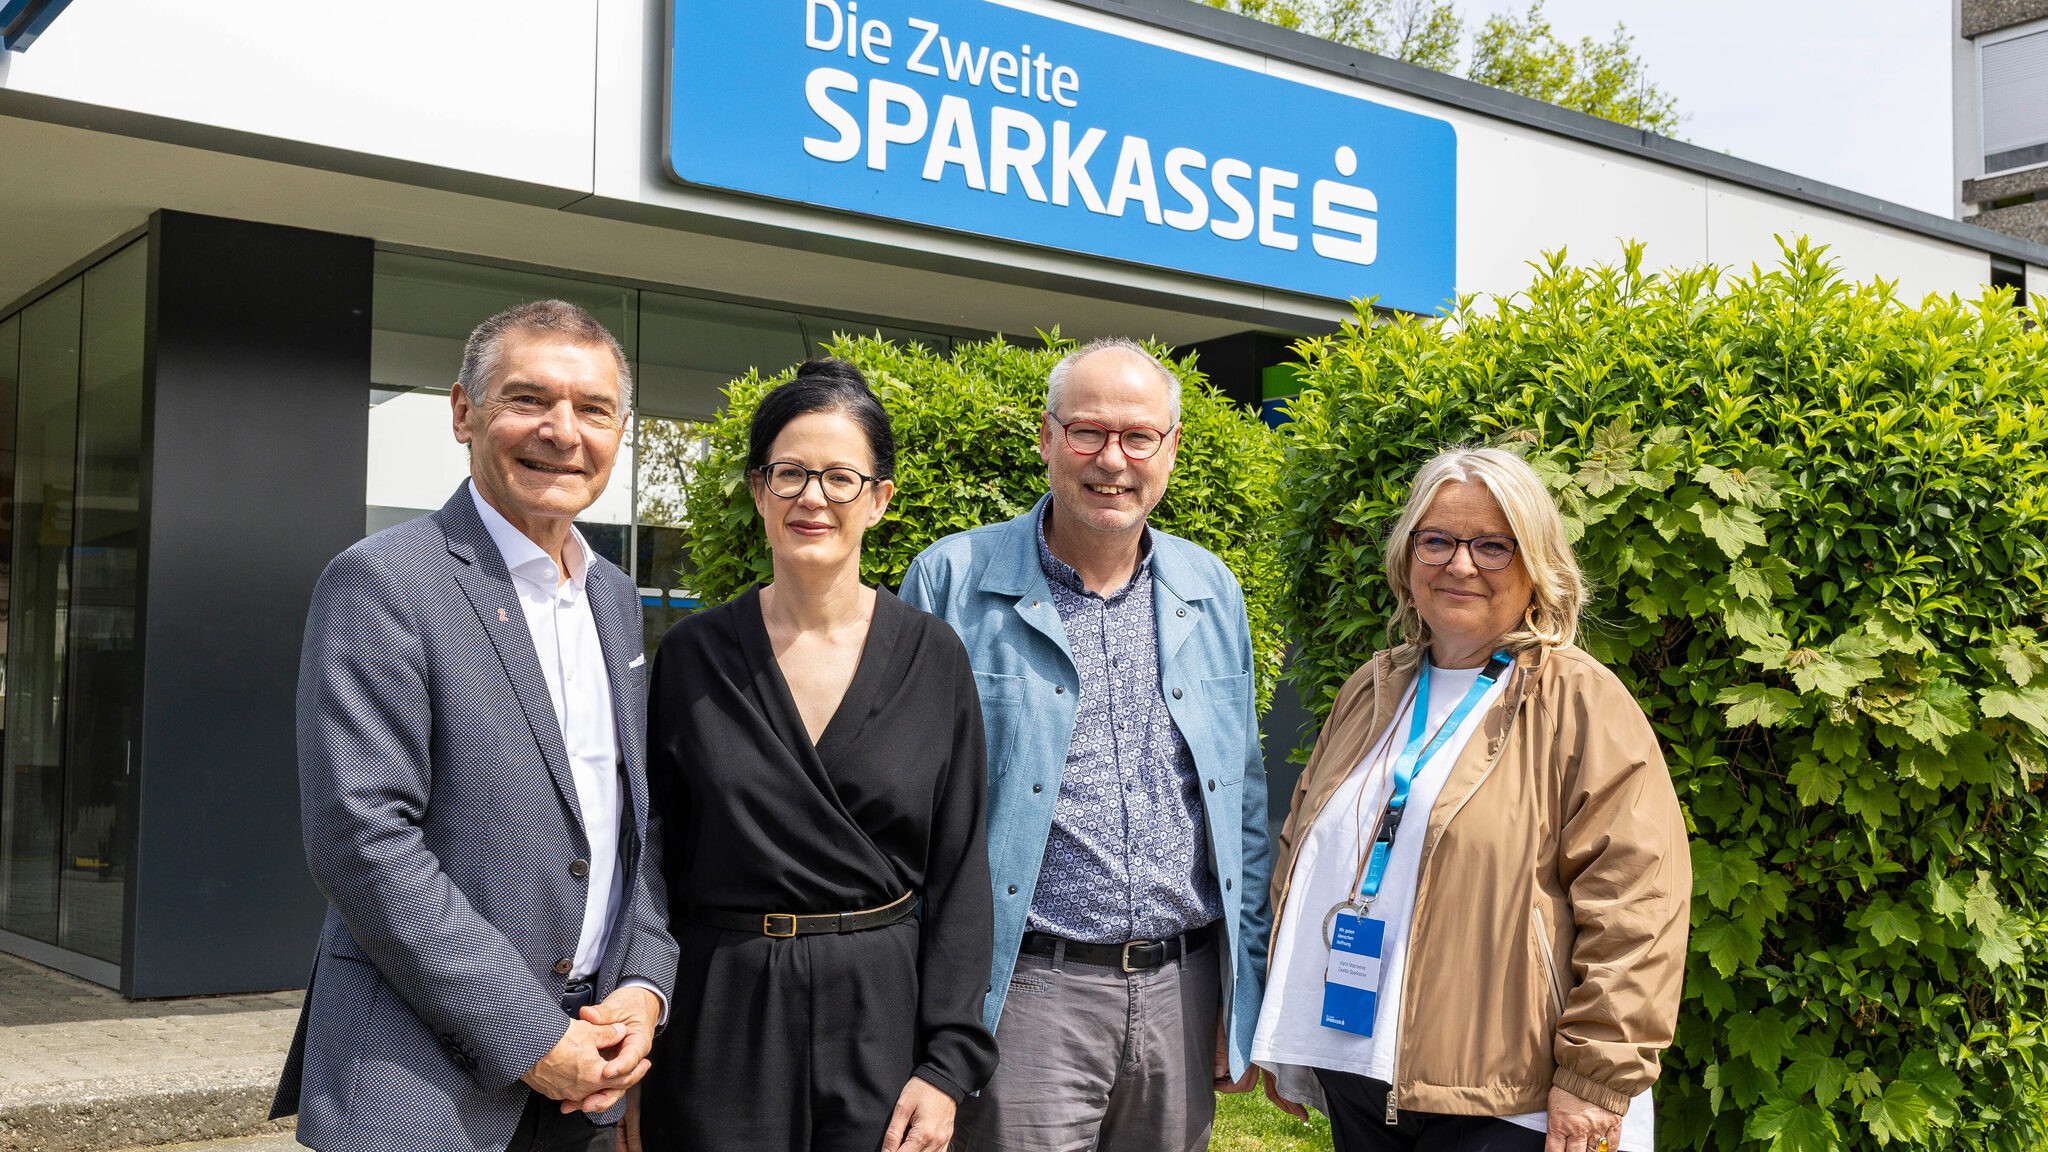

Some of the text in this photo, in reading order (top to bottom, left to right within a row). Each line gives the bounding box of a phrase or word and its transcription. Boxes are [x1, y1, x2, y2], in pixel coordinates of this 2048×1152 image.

[806, 0, 1080, 108] Die Zweite
[803, 66, 1299, 252] SPARKASSE
